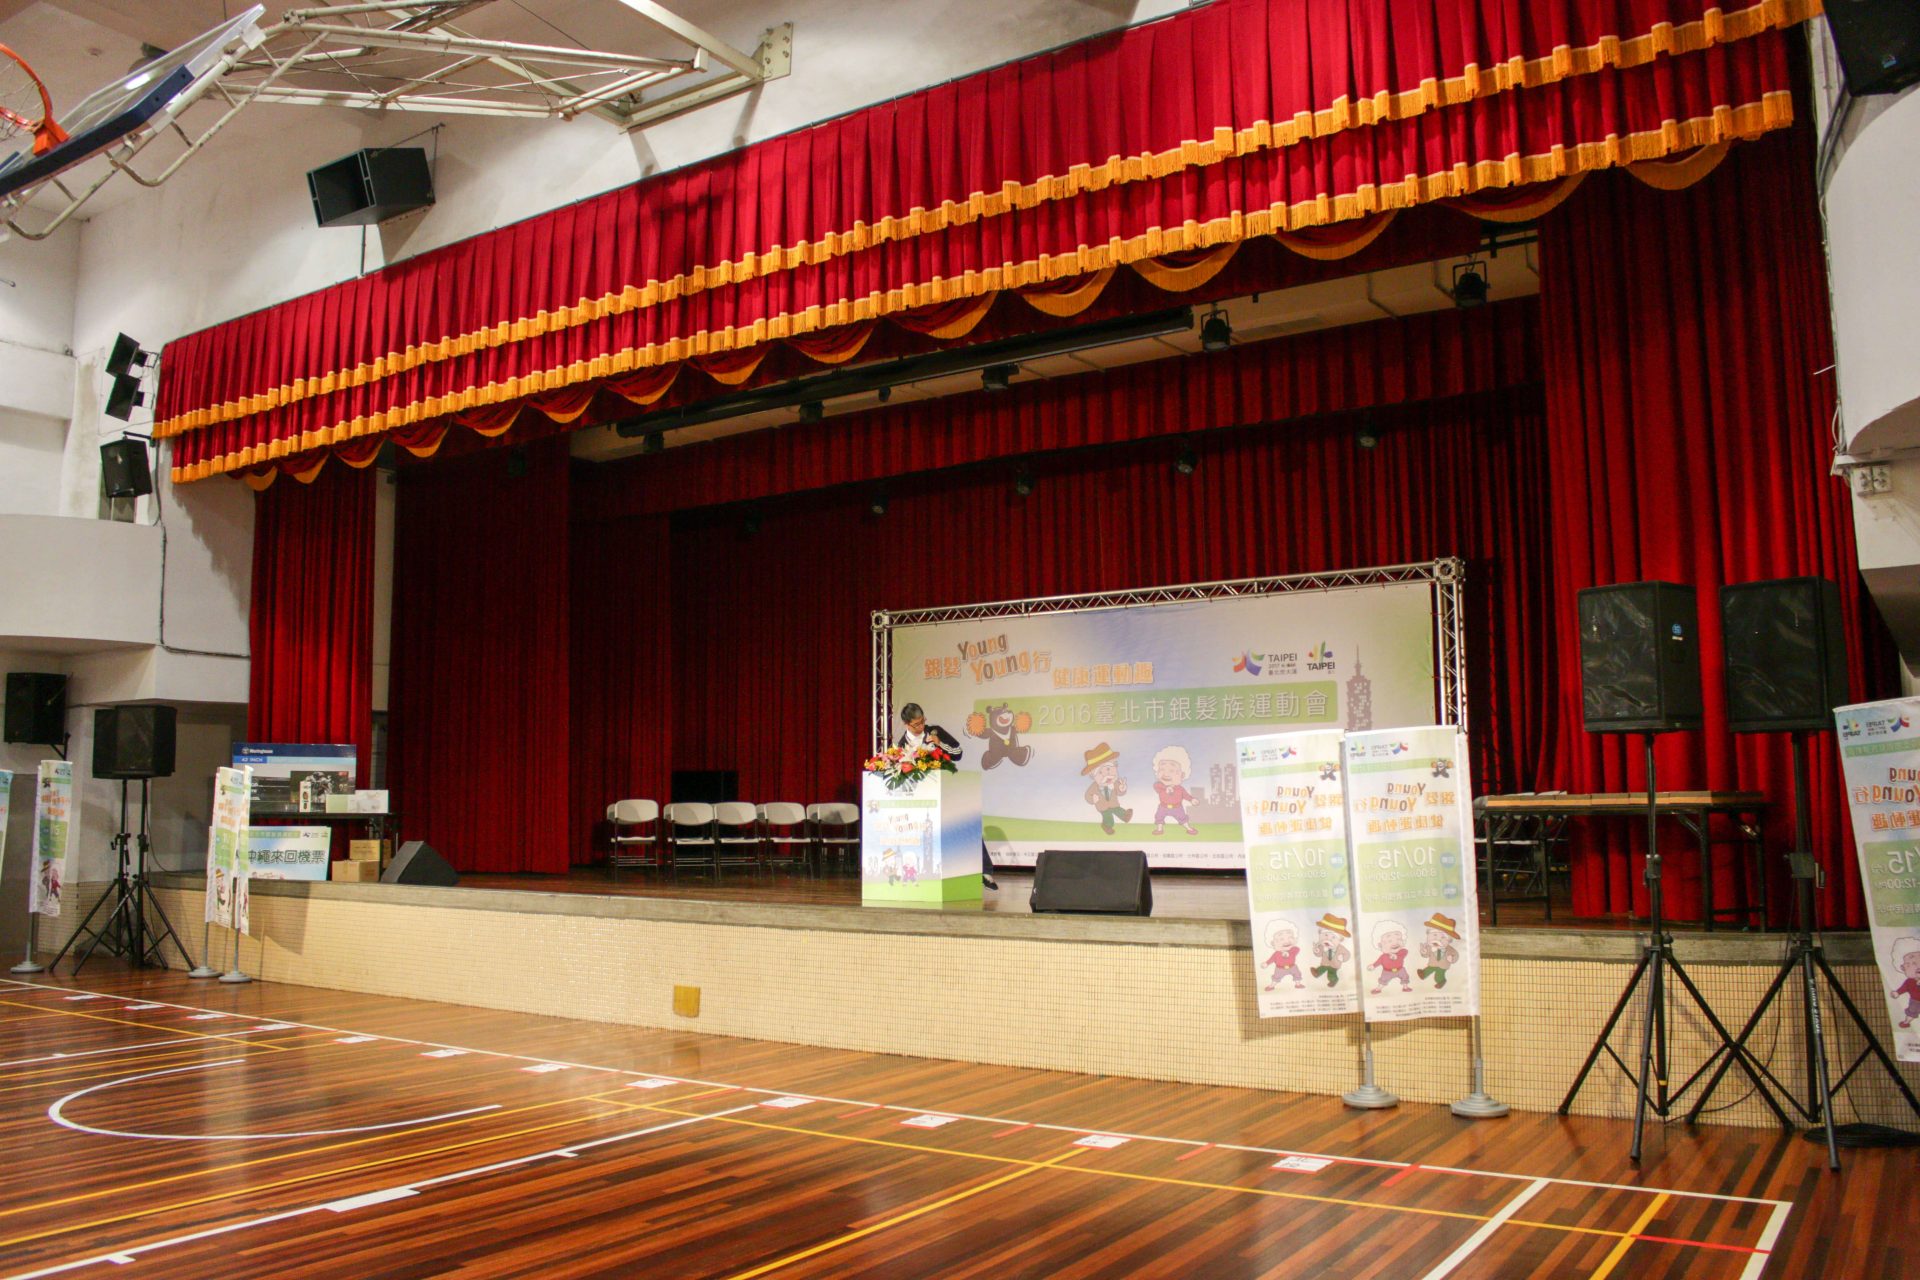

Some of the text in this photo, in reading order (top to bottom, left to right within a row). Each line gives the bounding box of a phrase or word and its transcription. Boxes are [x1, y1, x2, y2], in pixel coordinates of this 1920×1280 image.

[957, 633, 1008, 661] Young
[1268, 653, 1298, 663] TAIPEI
[923, 657, 961, 680] 銀髮
[1052, 661, 1154, 688] 健康運動趣
[1307, 661, 1336, 672] TAIPEI
[1038, 688, 1329, 727] 2016臺北市銀髮族運動會
